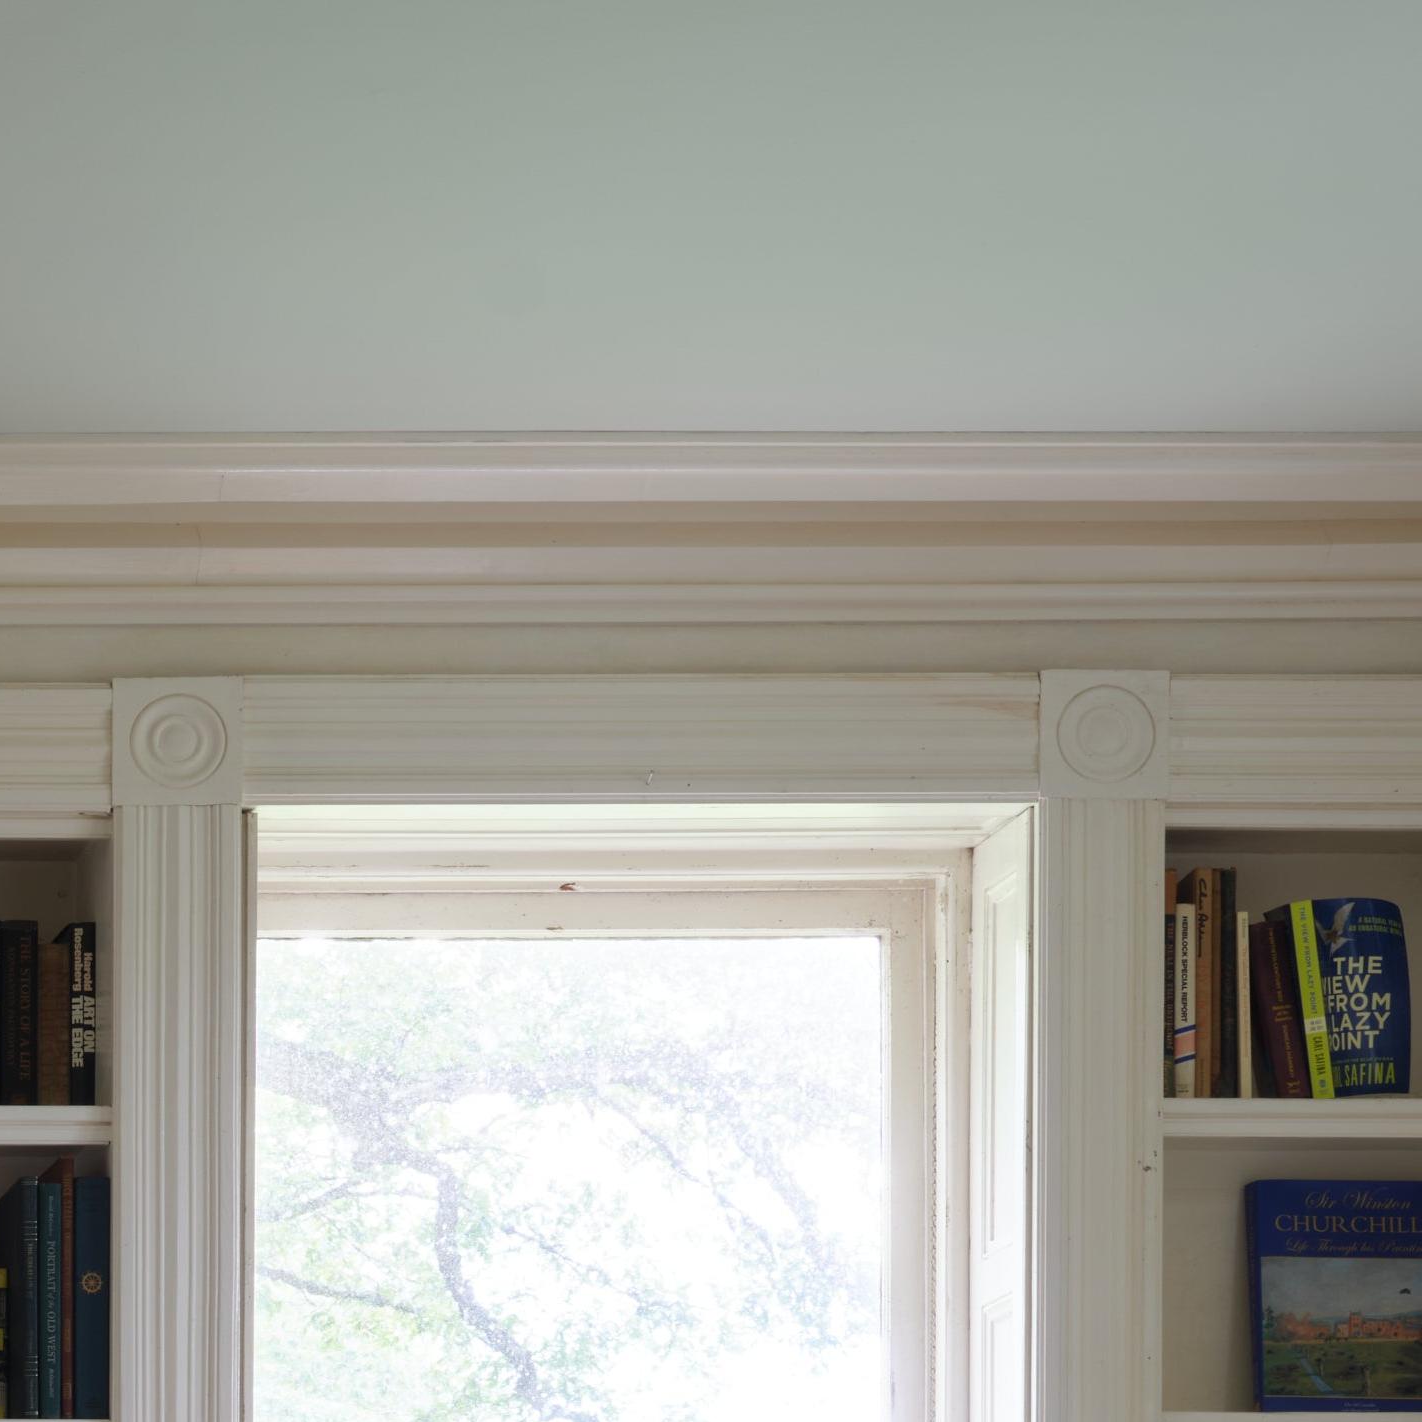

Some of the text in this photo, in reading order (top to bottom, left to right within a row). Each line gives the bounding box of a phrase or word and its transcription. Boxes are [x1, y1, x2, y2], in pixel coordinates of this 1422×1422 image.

[72, 927, 84, 991] Rosenberg
[1332, 955, 1384, 976] THE
[1327, 992, 1392, 1012] FROM
[71, 995, 84, 1068] THE EDGE
[84, 995, 95, 1053] ART ON
[1331, 1012, 1392, 1032] LAZY
[1344, 1062, 1396, 1087] SAFINA
[1343, 1190, 1413, 1210] Winston
[1274, 1214, 1422, 1233] CHURCHILL
[45, 1310, 56, 1364] OLD WEST
